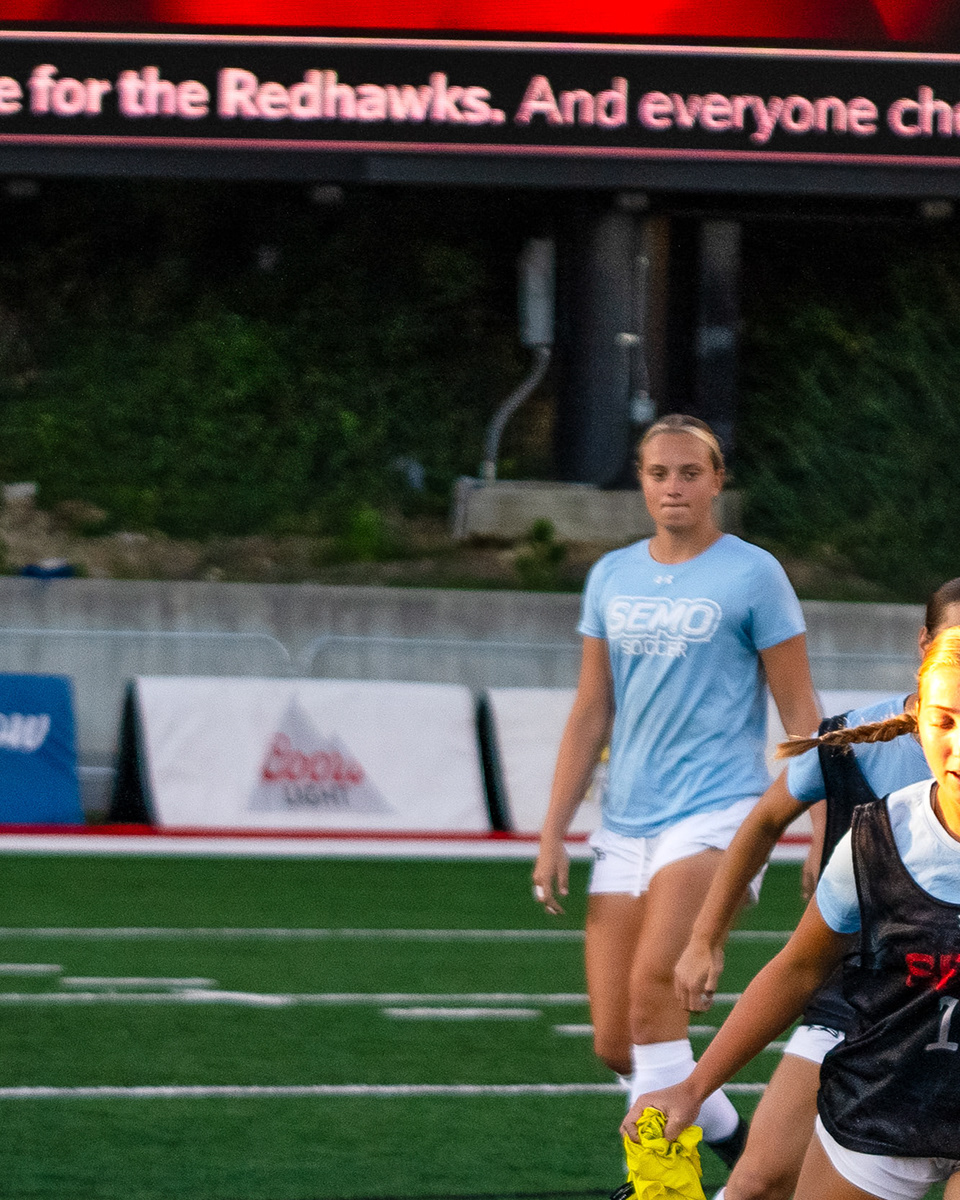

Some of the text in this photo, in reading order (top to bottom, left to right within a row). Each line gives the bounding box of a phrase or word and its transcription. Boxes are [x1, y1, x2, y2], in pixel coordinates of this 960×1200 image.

[27, 63, 111, 116] for
[116, 65, 208, 118] the
[216, 67, 506, 126] Redhawks.
[514, 74, 627, 128] And
[638, 91, 877, 143] everyone
[606, 599, 716, 636] SEMO
[620, 639, 688, 657] SOCCER
